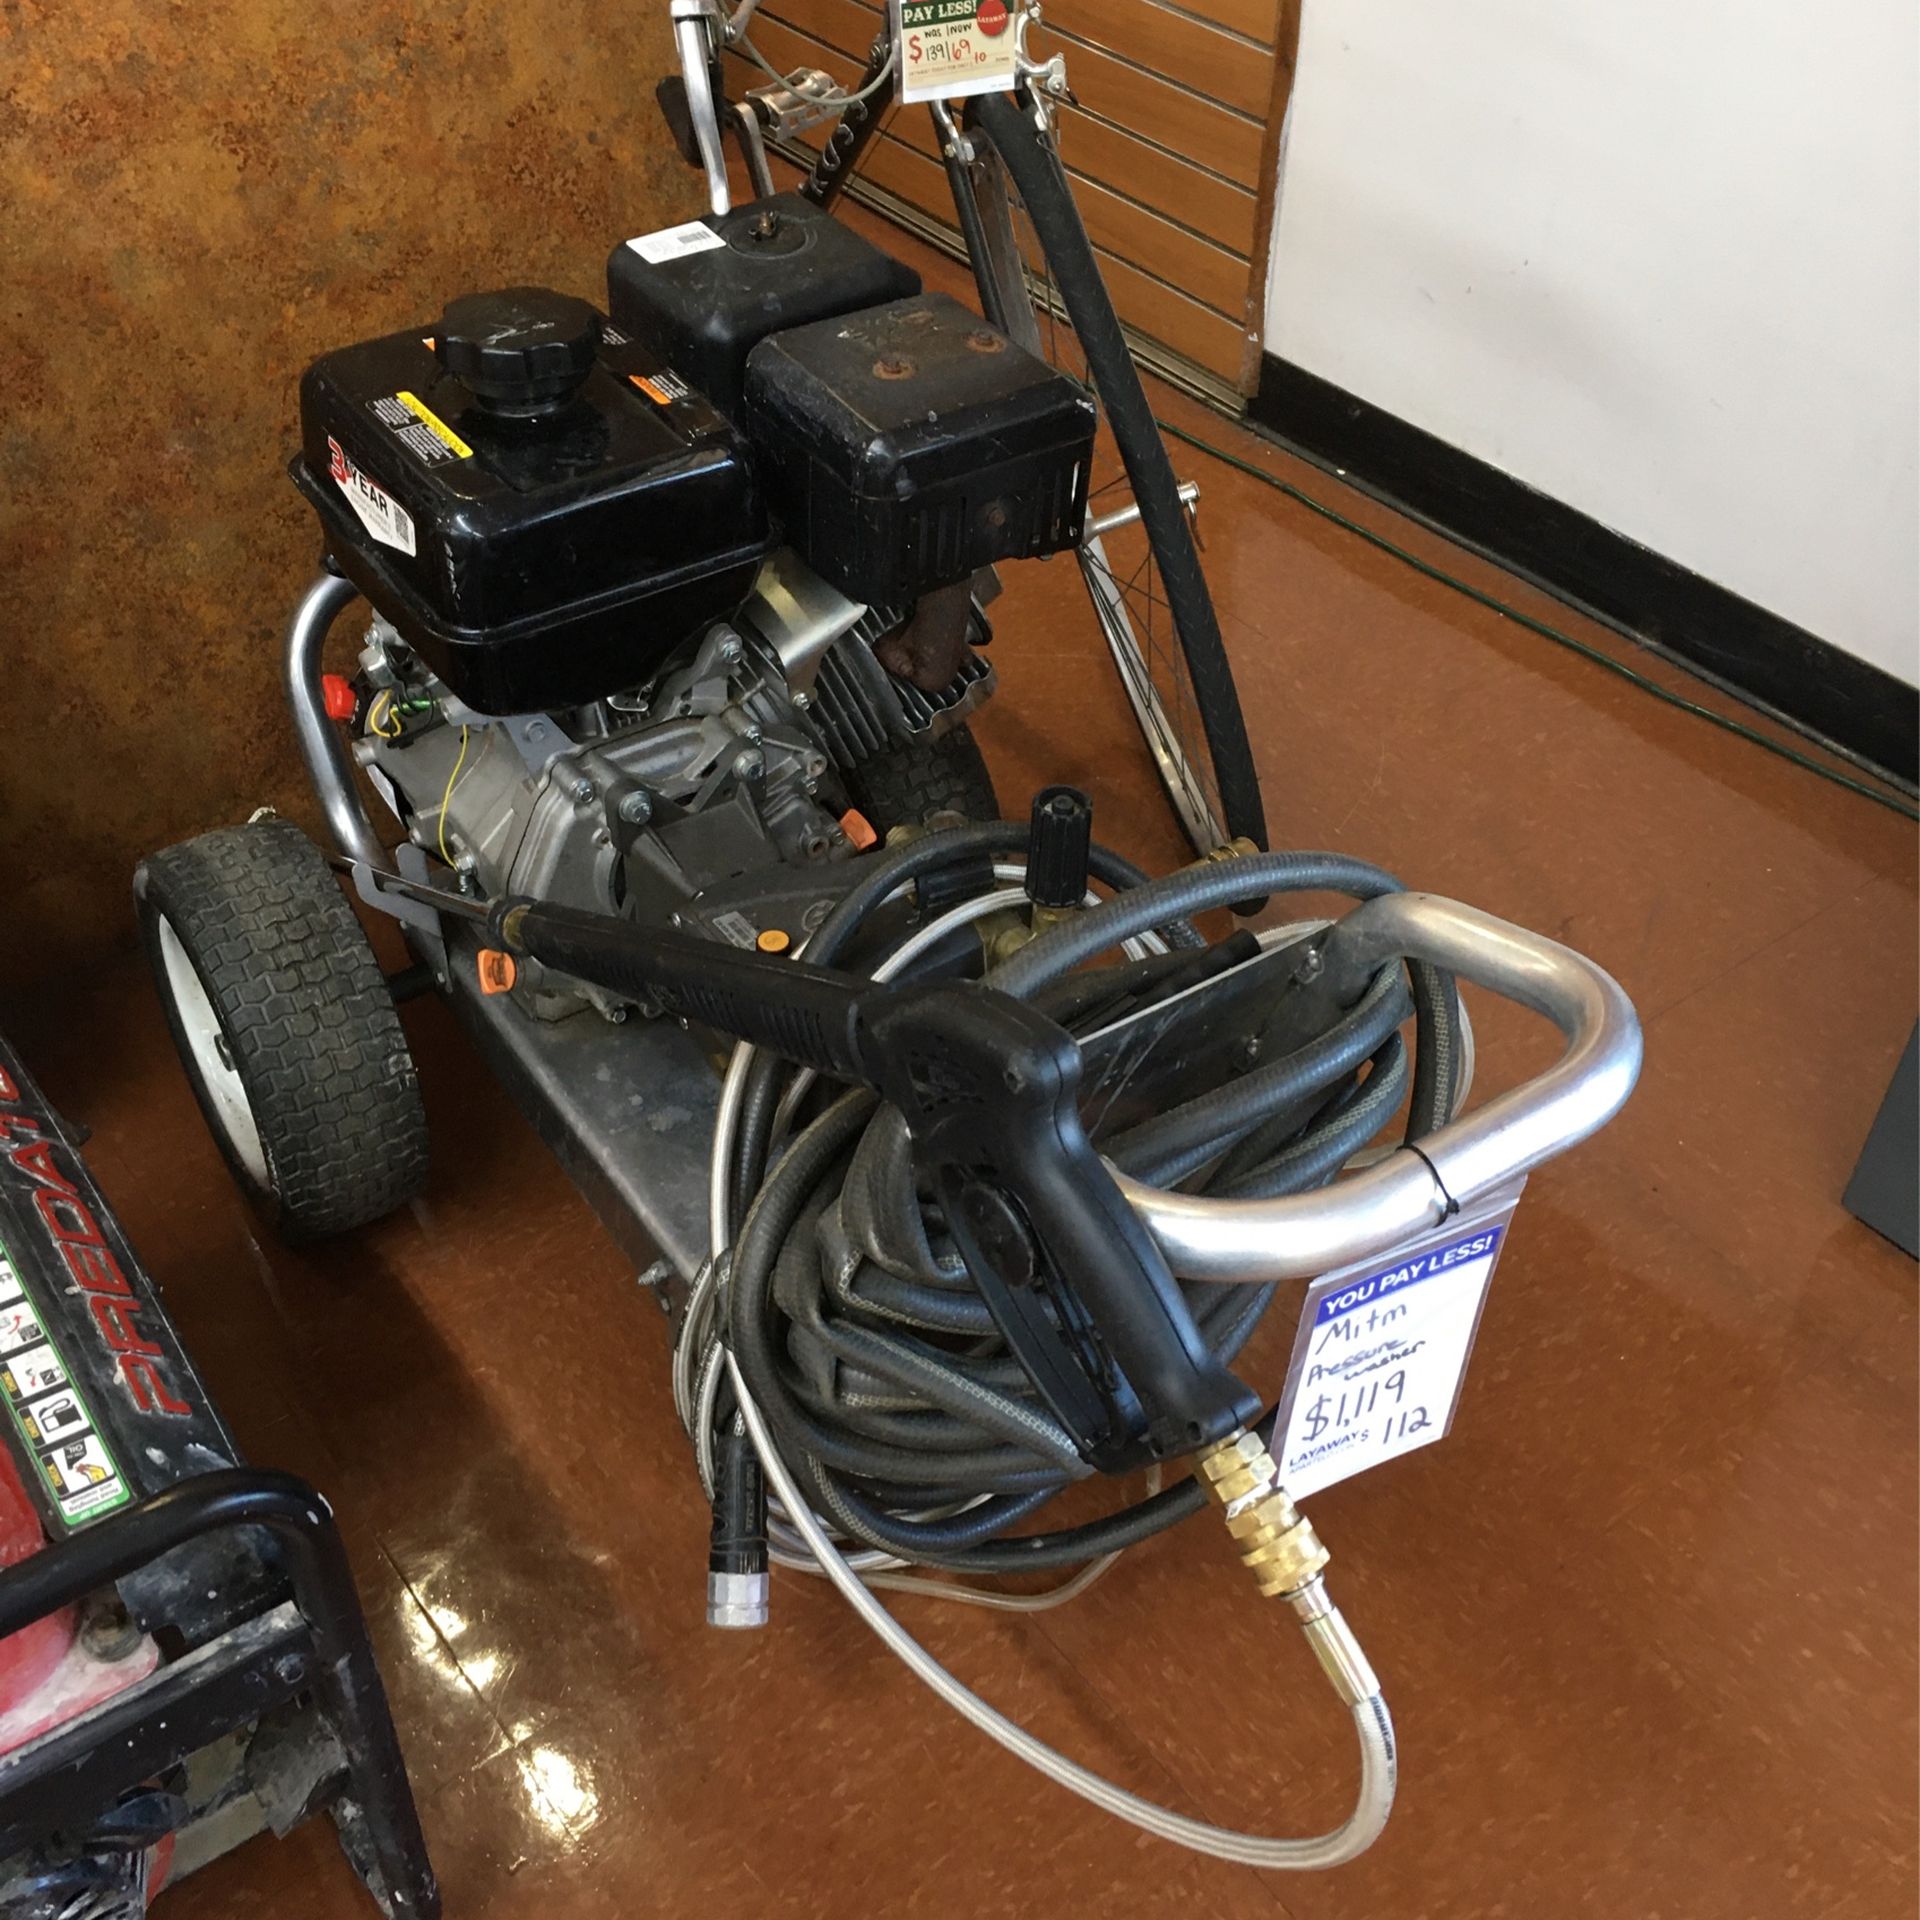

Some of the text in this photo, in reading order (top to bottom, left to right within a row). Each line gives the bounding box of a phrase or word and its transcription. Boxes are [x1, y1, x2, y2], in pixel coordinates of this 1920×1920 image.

[903, 0, 977, 24] PAY LESS!
[908, 34, 923, 64] $
[952, 39, 971, 60] 69
[351, 468, 389, 519] YEAR
[1325, 1234, 1494, 1316] YOU PAY LESS!
[1302, 1369, 1406, 1442] $1,119
[1382, 1406, 1433, 1445] 112
